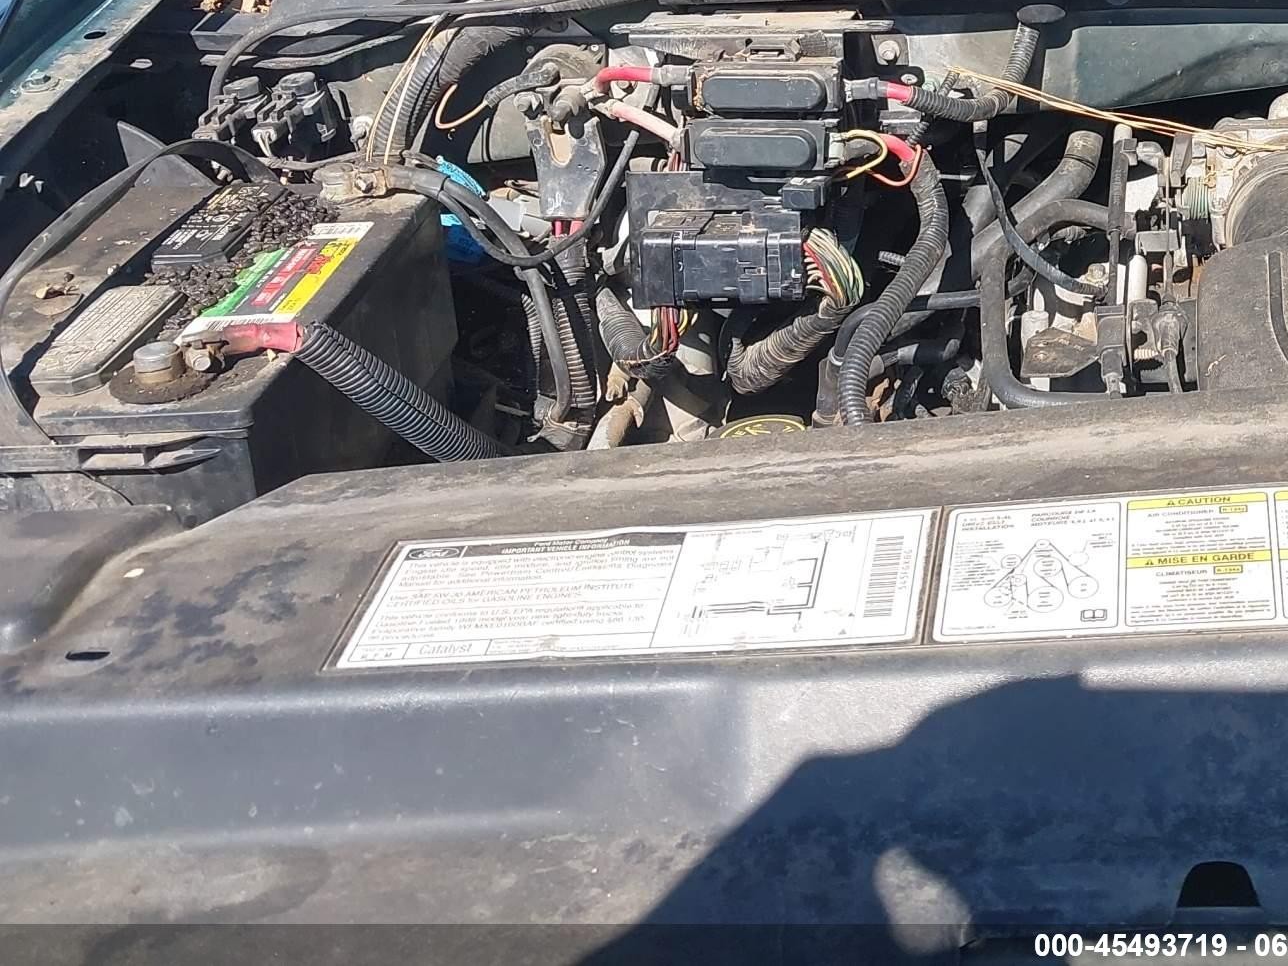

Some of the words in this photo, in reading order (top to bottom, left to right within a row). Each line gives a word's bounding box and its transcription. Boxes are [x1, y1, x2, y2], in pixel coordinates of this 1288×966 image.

[1177, 496, 1232, 506] CAUTION
[501, 546, 545, 555] IMPORTANT
[546, 544, 578, 552] VEHICLE
[579, 539, 631, 551] INFORMATION
[1158, 555, 1188, 565] MISE
[1192, 555, 1208, 563] EN
[1212, 552, 1255, 562] GARDE
[418, 642, 474, 655] Catalyst
